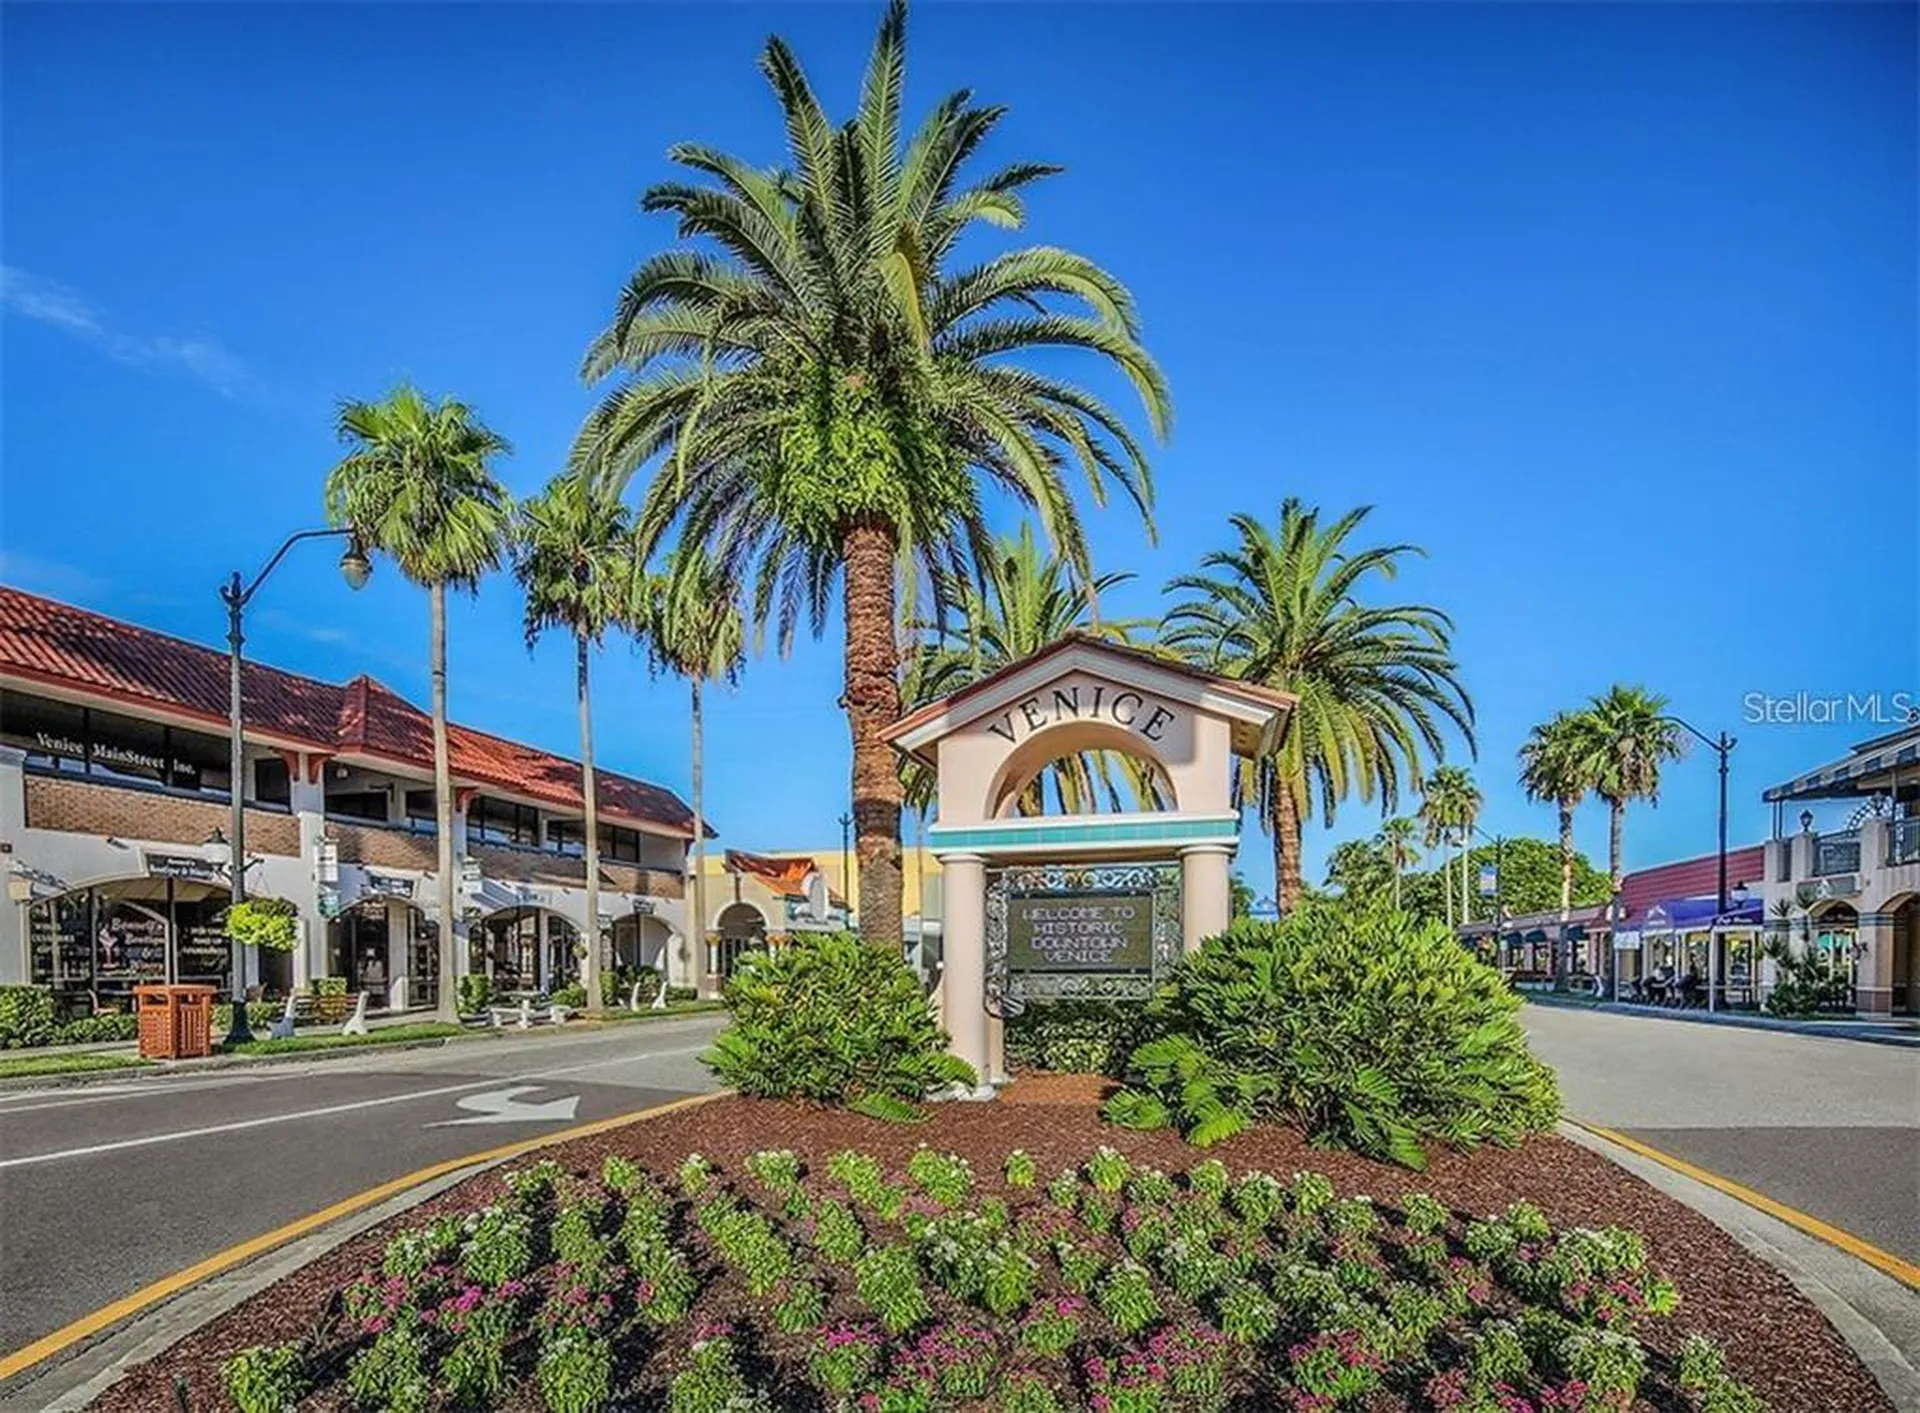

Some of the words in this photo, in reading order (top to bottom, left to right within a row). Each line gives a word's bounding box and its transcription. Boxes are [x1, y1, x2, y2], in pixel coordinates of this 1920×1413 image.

[987, 686, 1175, 744] VENICE
[36, 732, 84, 754] Venice
[92, 743, 165, 769] MainStreet
[173, 758, 196, 775] Inc.
[1021, 906, 1105, 920] WELCOME
[1110, 906, 1135, 919] TO
[1033, 921, 1124, 935] HISTORIC
[1031, 936, 1128, 950] DOWNTOWN
[1045, 950, 1112, 963] VENICE
